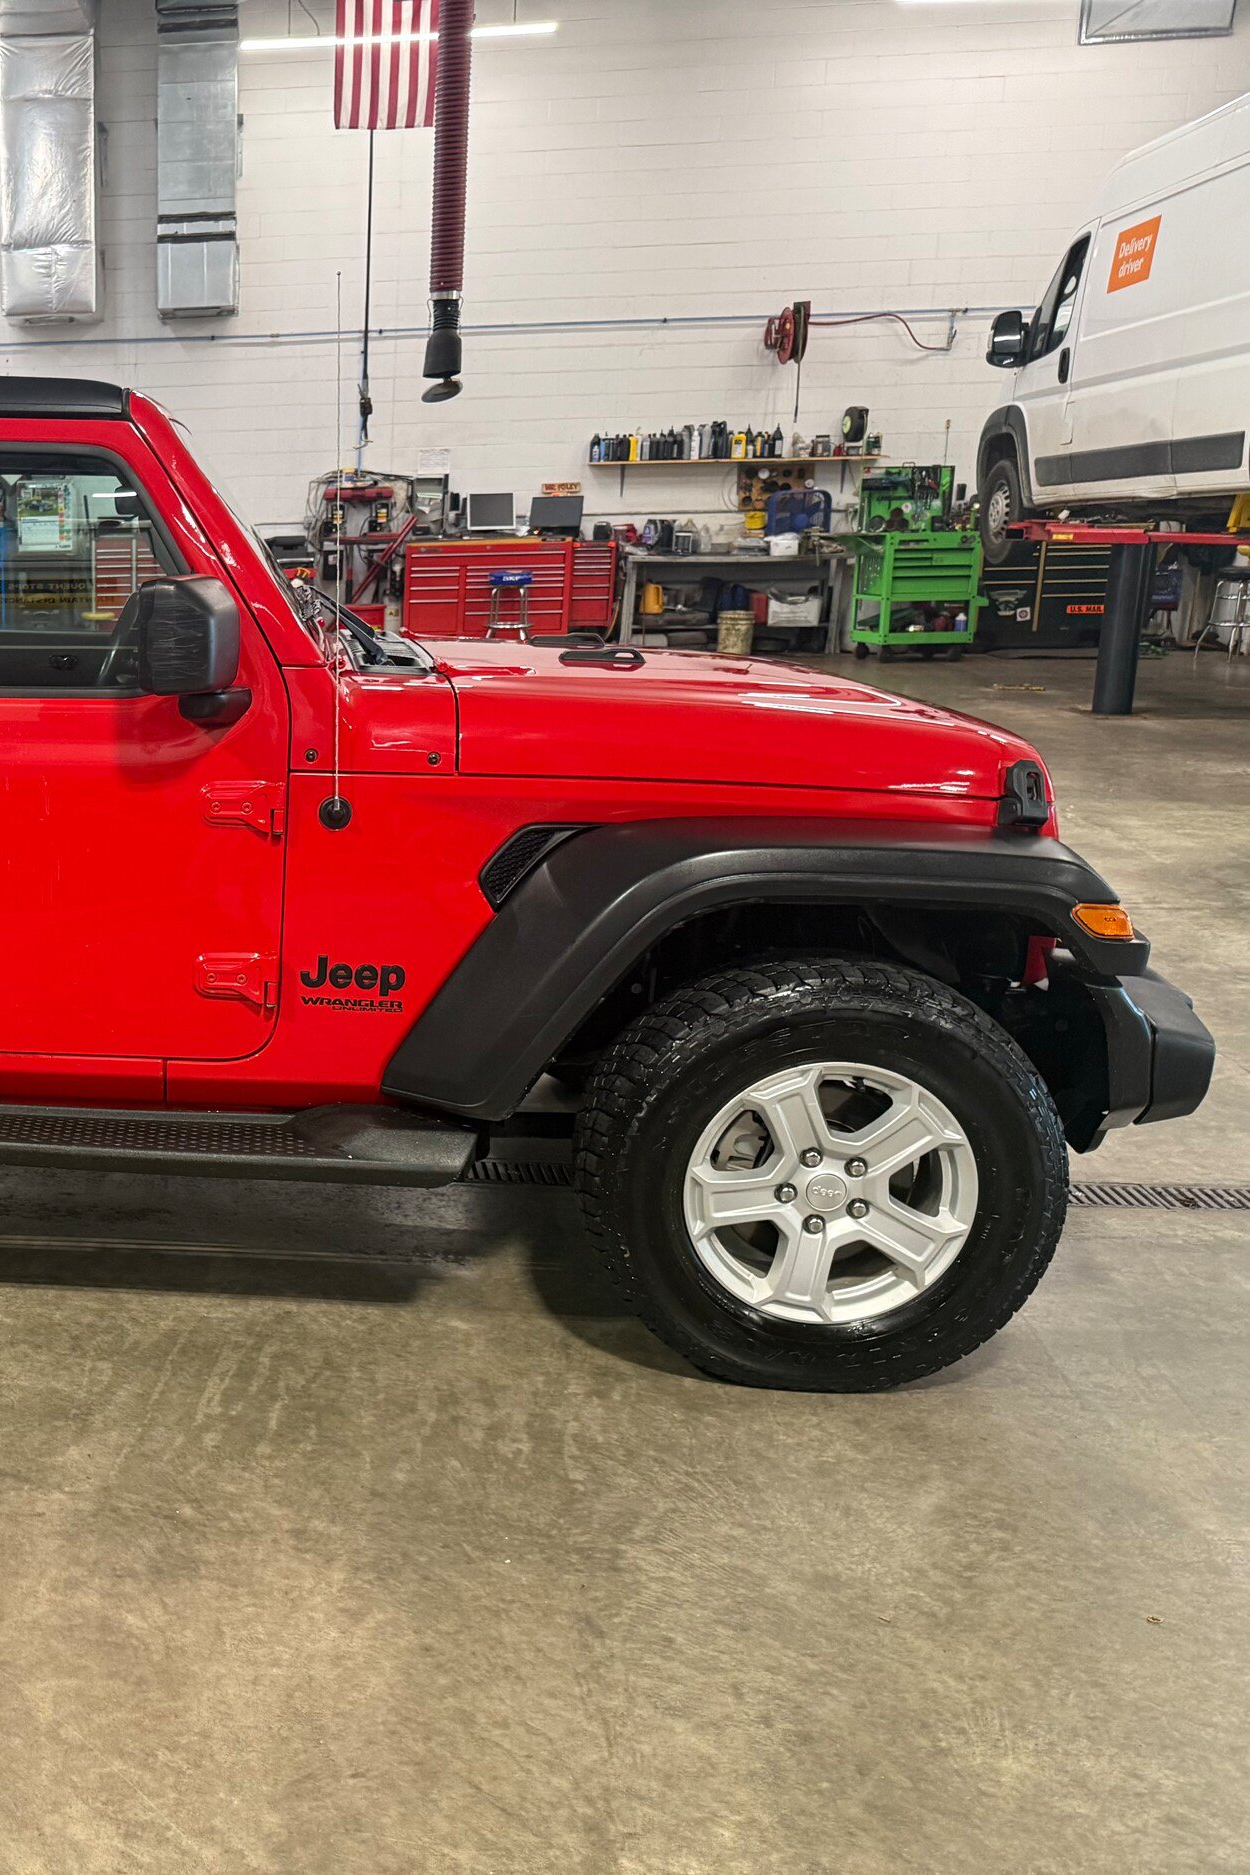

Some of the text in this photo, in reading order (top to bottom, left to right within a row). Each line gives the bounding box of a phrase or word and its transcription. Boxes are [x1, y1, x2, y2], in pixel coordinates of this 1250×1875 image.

[1118, 234, 1153, 259] Delivery
[1118, 257, 1145, 279] driver
[300, 955, 405, 996] Jeep
[301, 996, 403, 1008] WRANGLER
[332, 1005, 403, 1013] UNLIMITED
